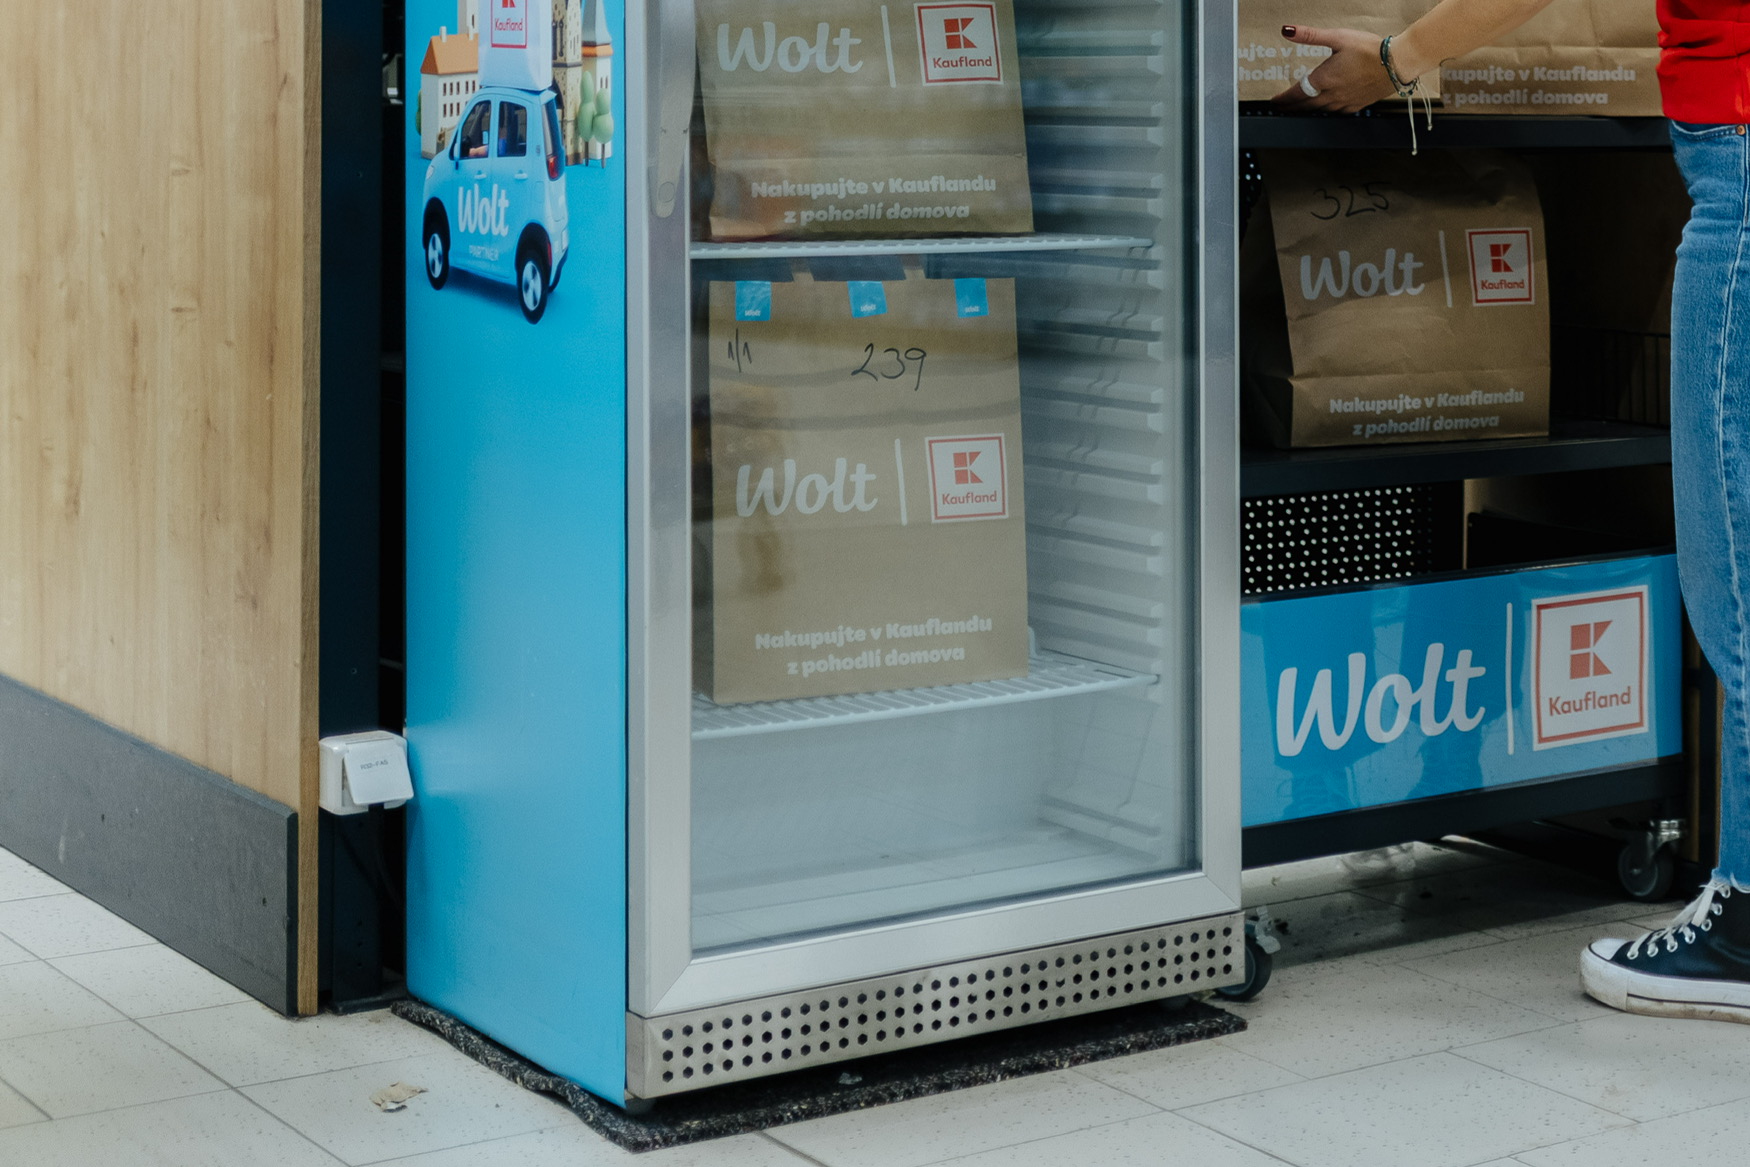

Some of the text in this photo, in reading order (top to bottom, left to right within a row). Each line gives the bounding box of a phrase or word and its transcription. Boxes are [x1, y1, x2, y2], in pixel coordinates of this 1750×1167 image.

[494, 18, 523, 31] Kaufland
[716, 21, 863, 74] Wolt
[932, 55, 993, 69] Kaufland
[1519, 68, 1530, 81] v
[1533, 65, 1636, 82] Kauflandu
[1455, 88, 1528, 107] pohodlí
[1531, 90, 1609, 105] domova
[752, 175, 996, 200] Nakupujte v Kauflandu
[1310, 181, 1392, 220] 325
[458, 183, 510, 237] Wolt
[784, 202, 970, 227] z pohodlí domova
[1299, 248, 1425, 300] Wolt
[1480, 278, 1525, 291] Kaufland
[851, 342, 927, 391] 239
[1329, 387, 1524, 416] Nakupujte v Kauflandu
[1352, 413, 1501, 438] z pohodlí domova
[735, 457, 878, 518] Wolt
[941, 491, 998, 506] Kaufland
[755, 615, 992, 650] Nakupujte v Kauflandu
[787, 646, 965, 678] z pohodlí domova
[1275, 643, 1487, 758] Wolt
[1548, 687, 1632, 717] Kaufland
